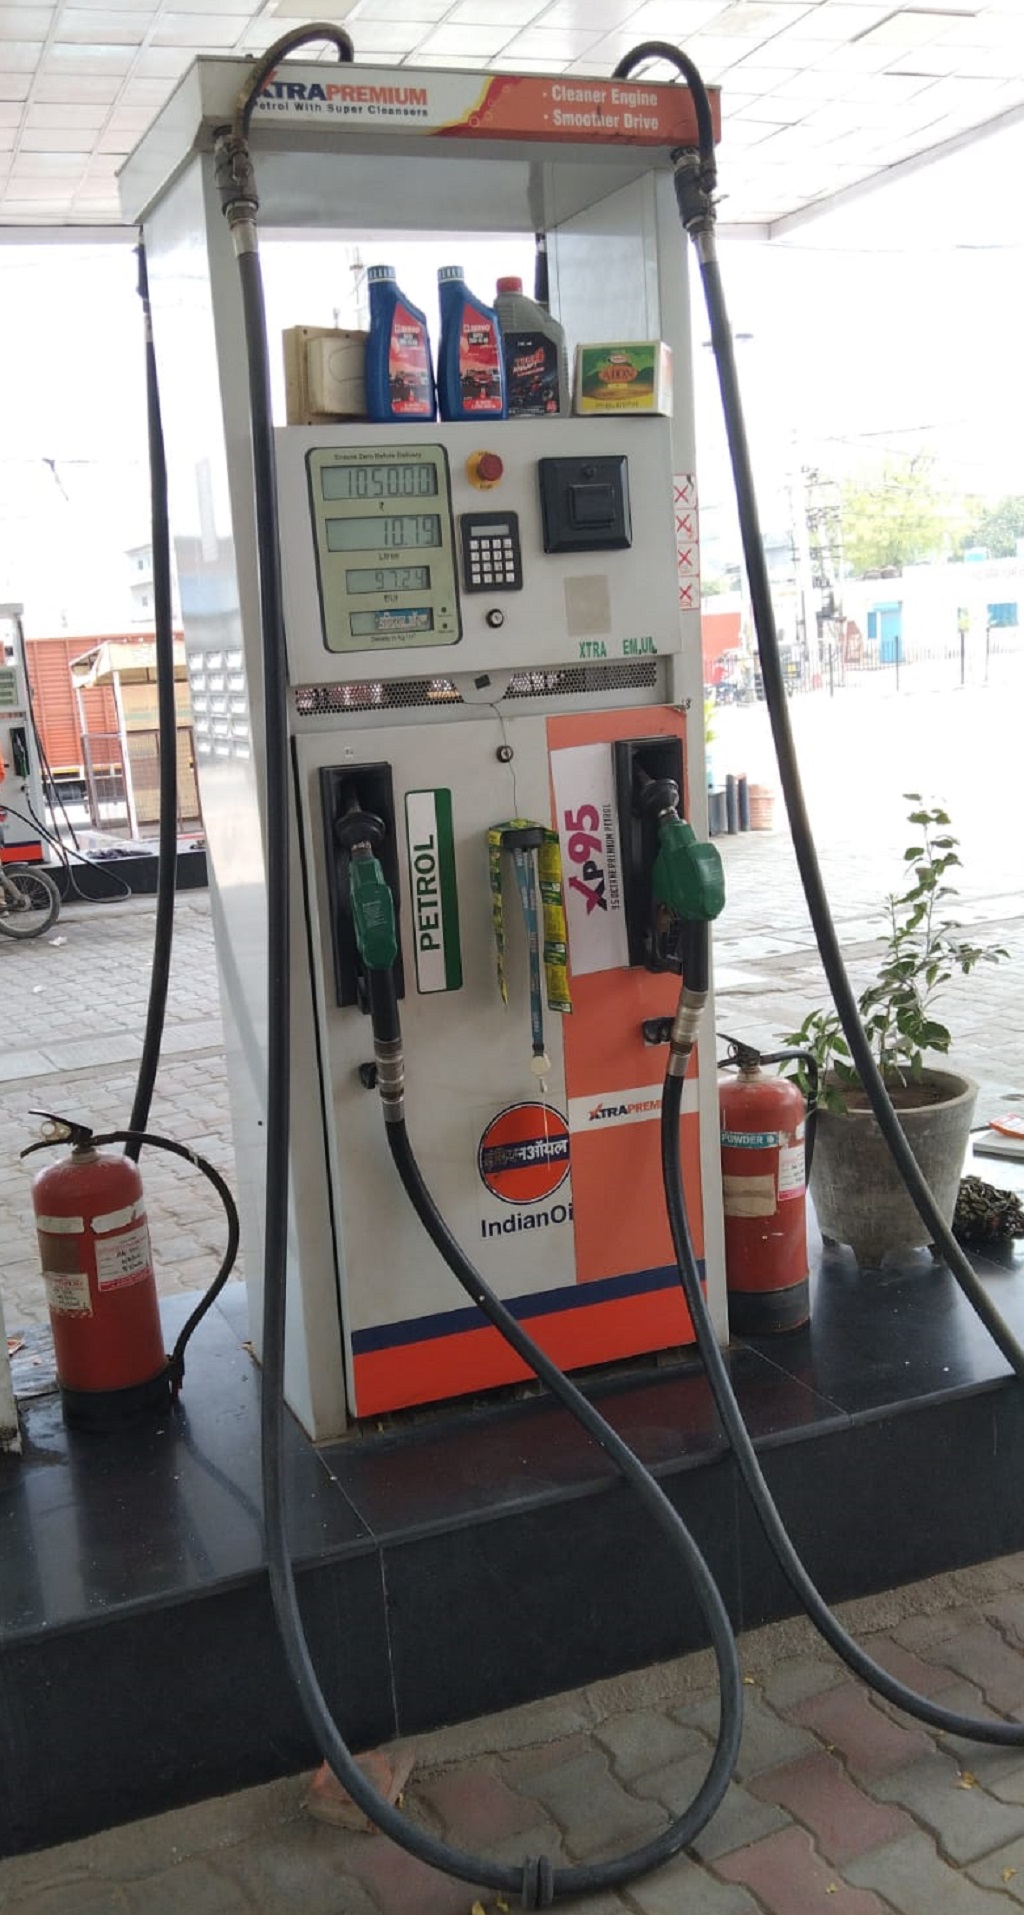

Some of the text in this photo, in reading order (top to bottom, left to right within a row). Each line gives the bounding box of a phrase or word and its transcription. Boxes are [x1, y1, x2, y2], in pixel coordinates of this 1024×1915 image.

[552, 85, 658, 108] Cleaner Engine
[254, 101, 429, 117] etrol With Super Cleansers
[623, 114, 659, 130] Drive
[348, 466, 430, 496] 1050.00
[384, 517, 434, 546] 10.79
[375, 570, 424, 590] 97.24
[579, 641, 607, 658] XTRA
[564, 804, 607, 916] XP95
[413, 834, 440, 952] PETROL
[721, 1133, 763, 1144] POWDER
